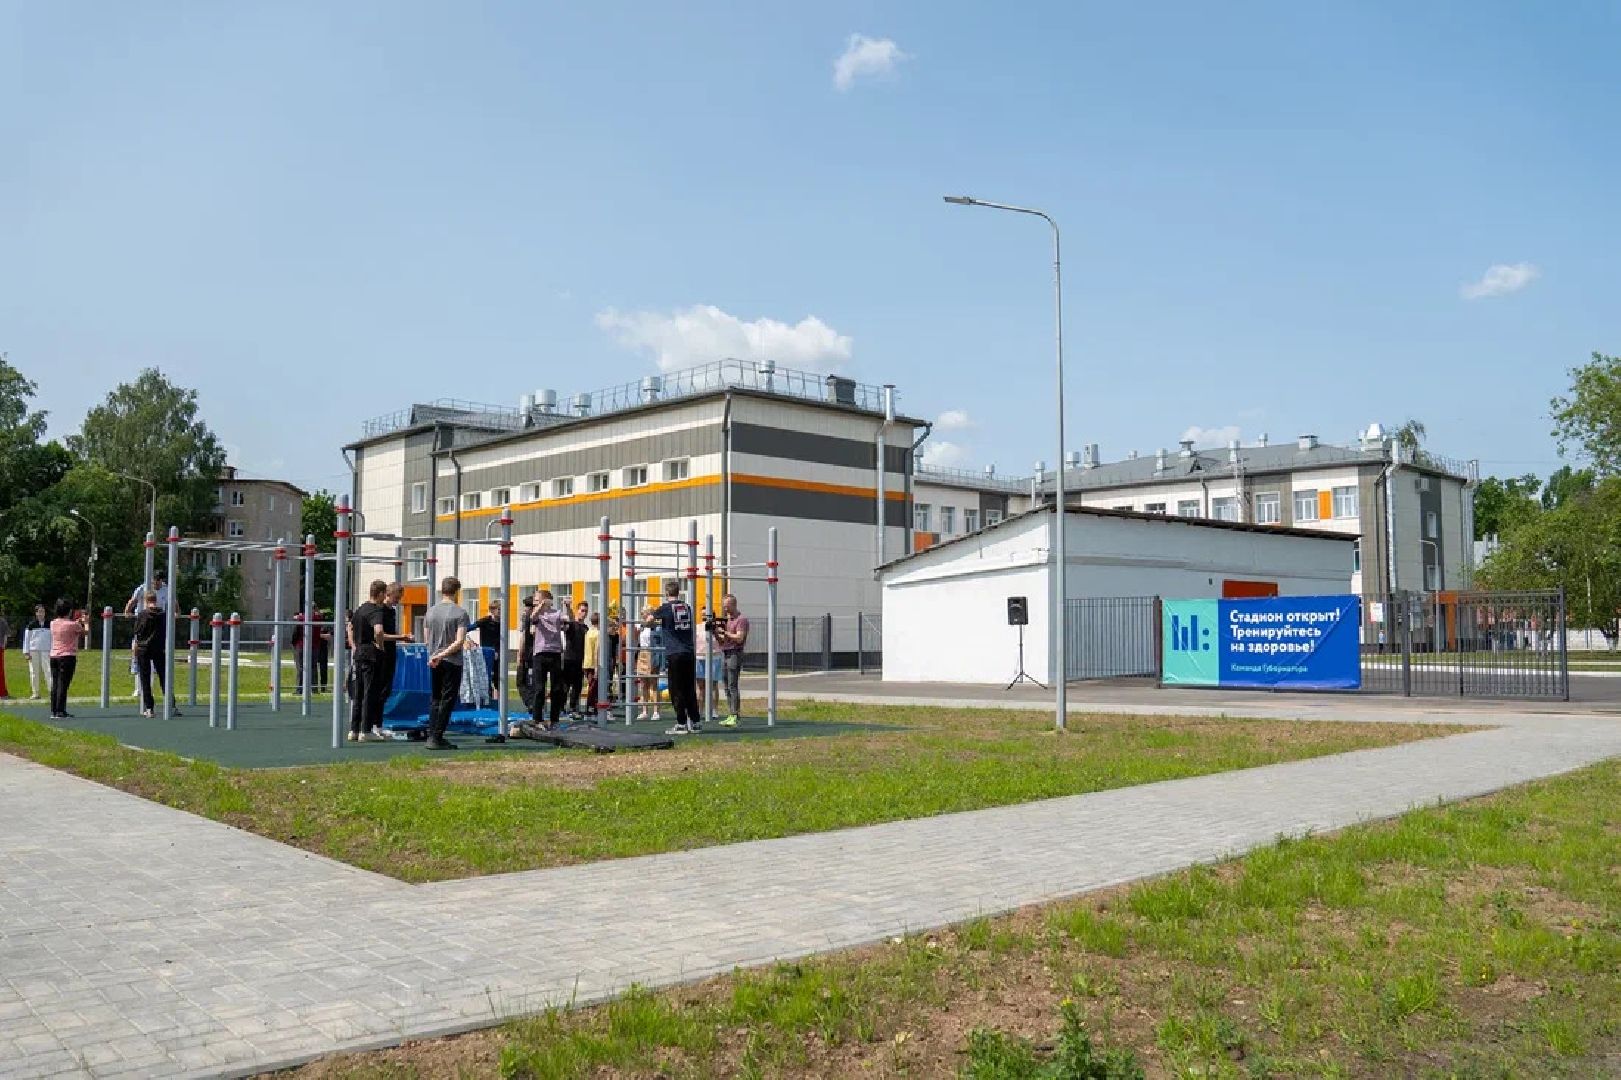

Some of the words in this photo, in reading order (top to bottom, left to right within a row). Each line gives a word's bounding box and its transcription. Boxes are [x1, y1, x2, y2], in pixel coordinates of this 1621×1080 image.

[1230, 610, 1283, 623] Стадион
[1286, 607, 1340, 624] открыт!
[1230, 625, 1322, 640] Тренируйтесь
[1230, 643, 1244, 652] на
[1248, 640, 1315, 655] здоровье!
